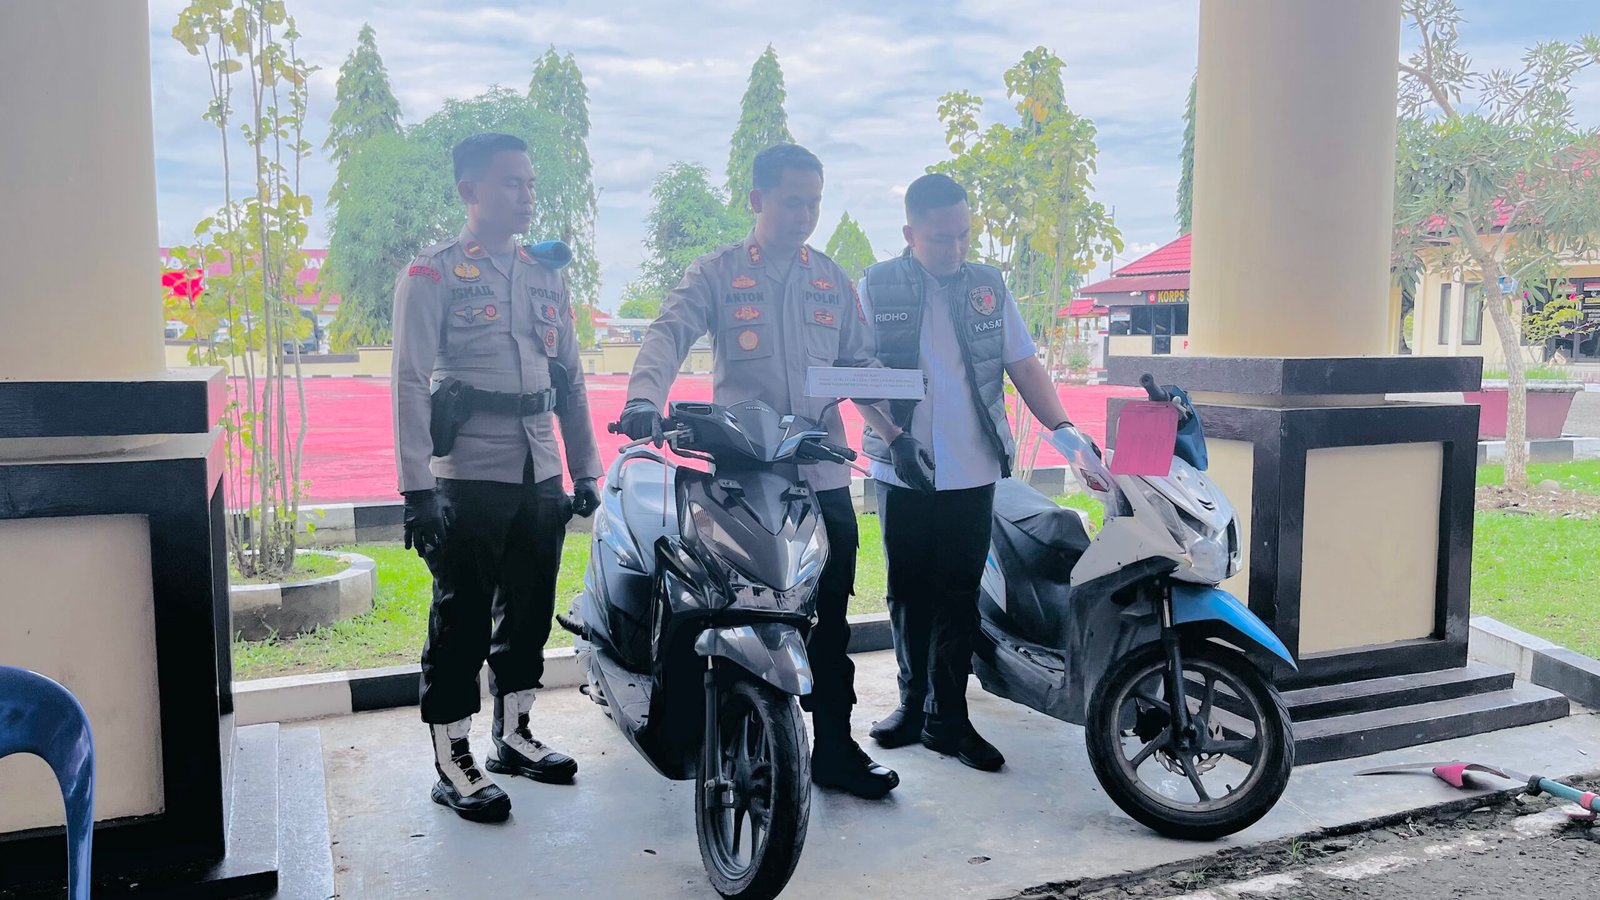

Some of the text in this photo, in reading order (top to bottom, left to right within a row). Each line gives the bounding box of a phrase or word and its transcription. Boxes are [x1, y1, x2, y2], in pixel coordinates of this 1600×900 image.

[451, 286, 495, 300] ISMAIL
[725, 291, 764, 303] ANTON
[805, 291, 840, 304] POLRI
[1158, 291, 1185, 302] KORPS
[875, 312, 908, 323] RIDHO
[974, 318, 1003, 333] KASAT
